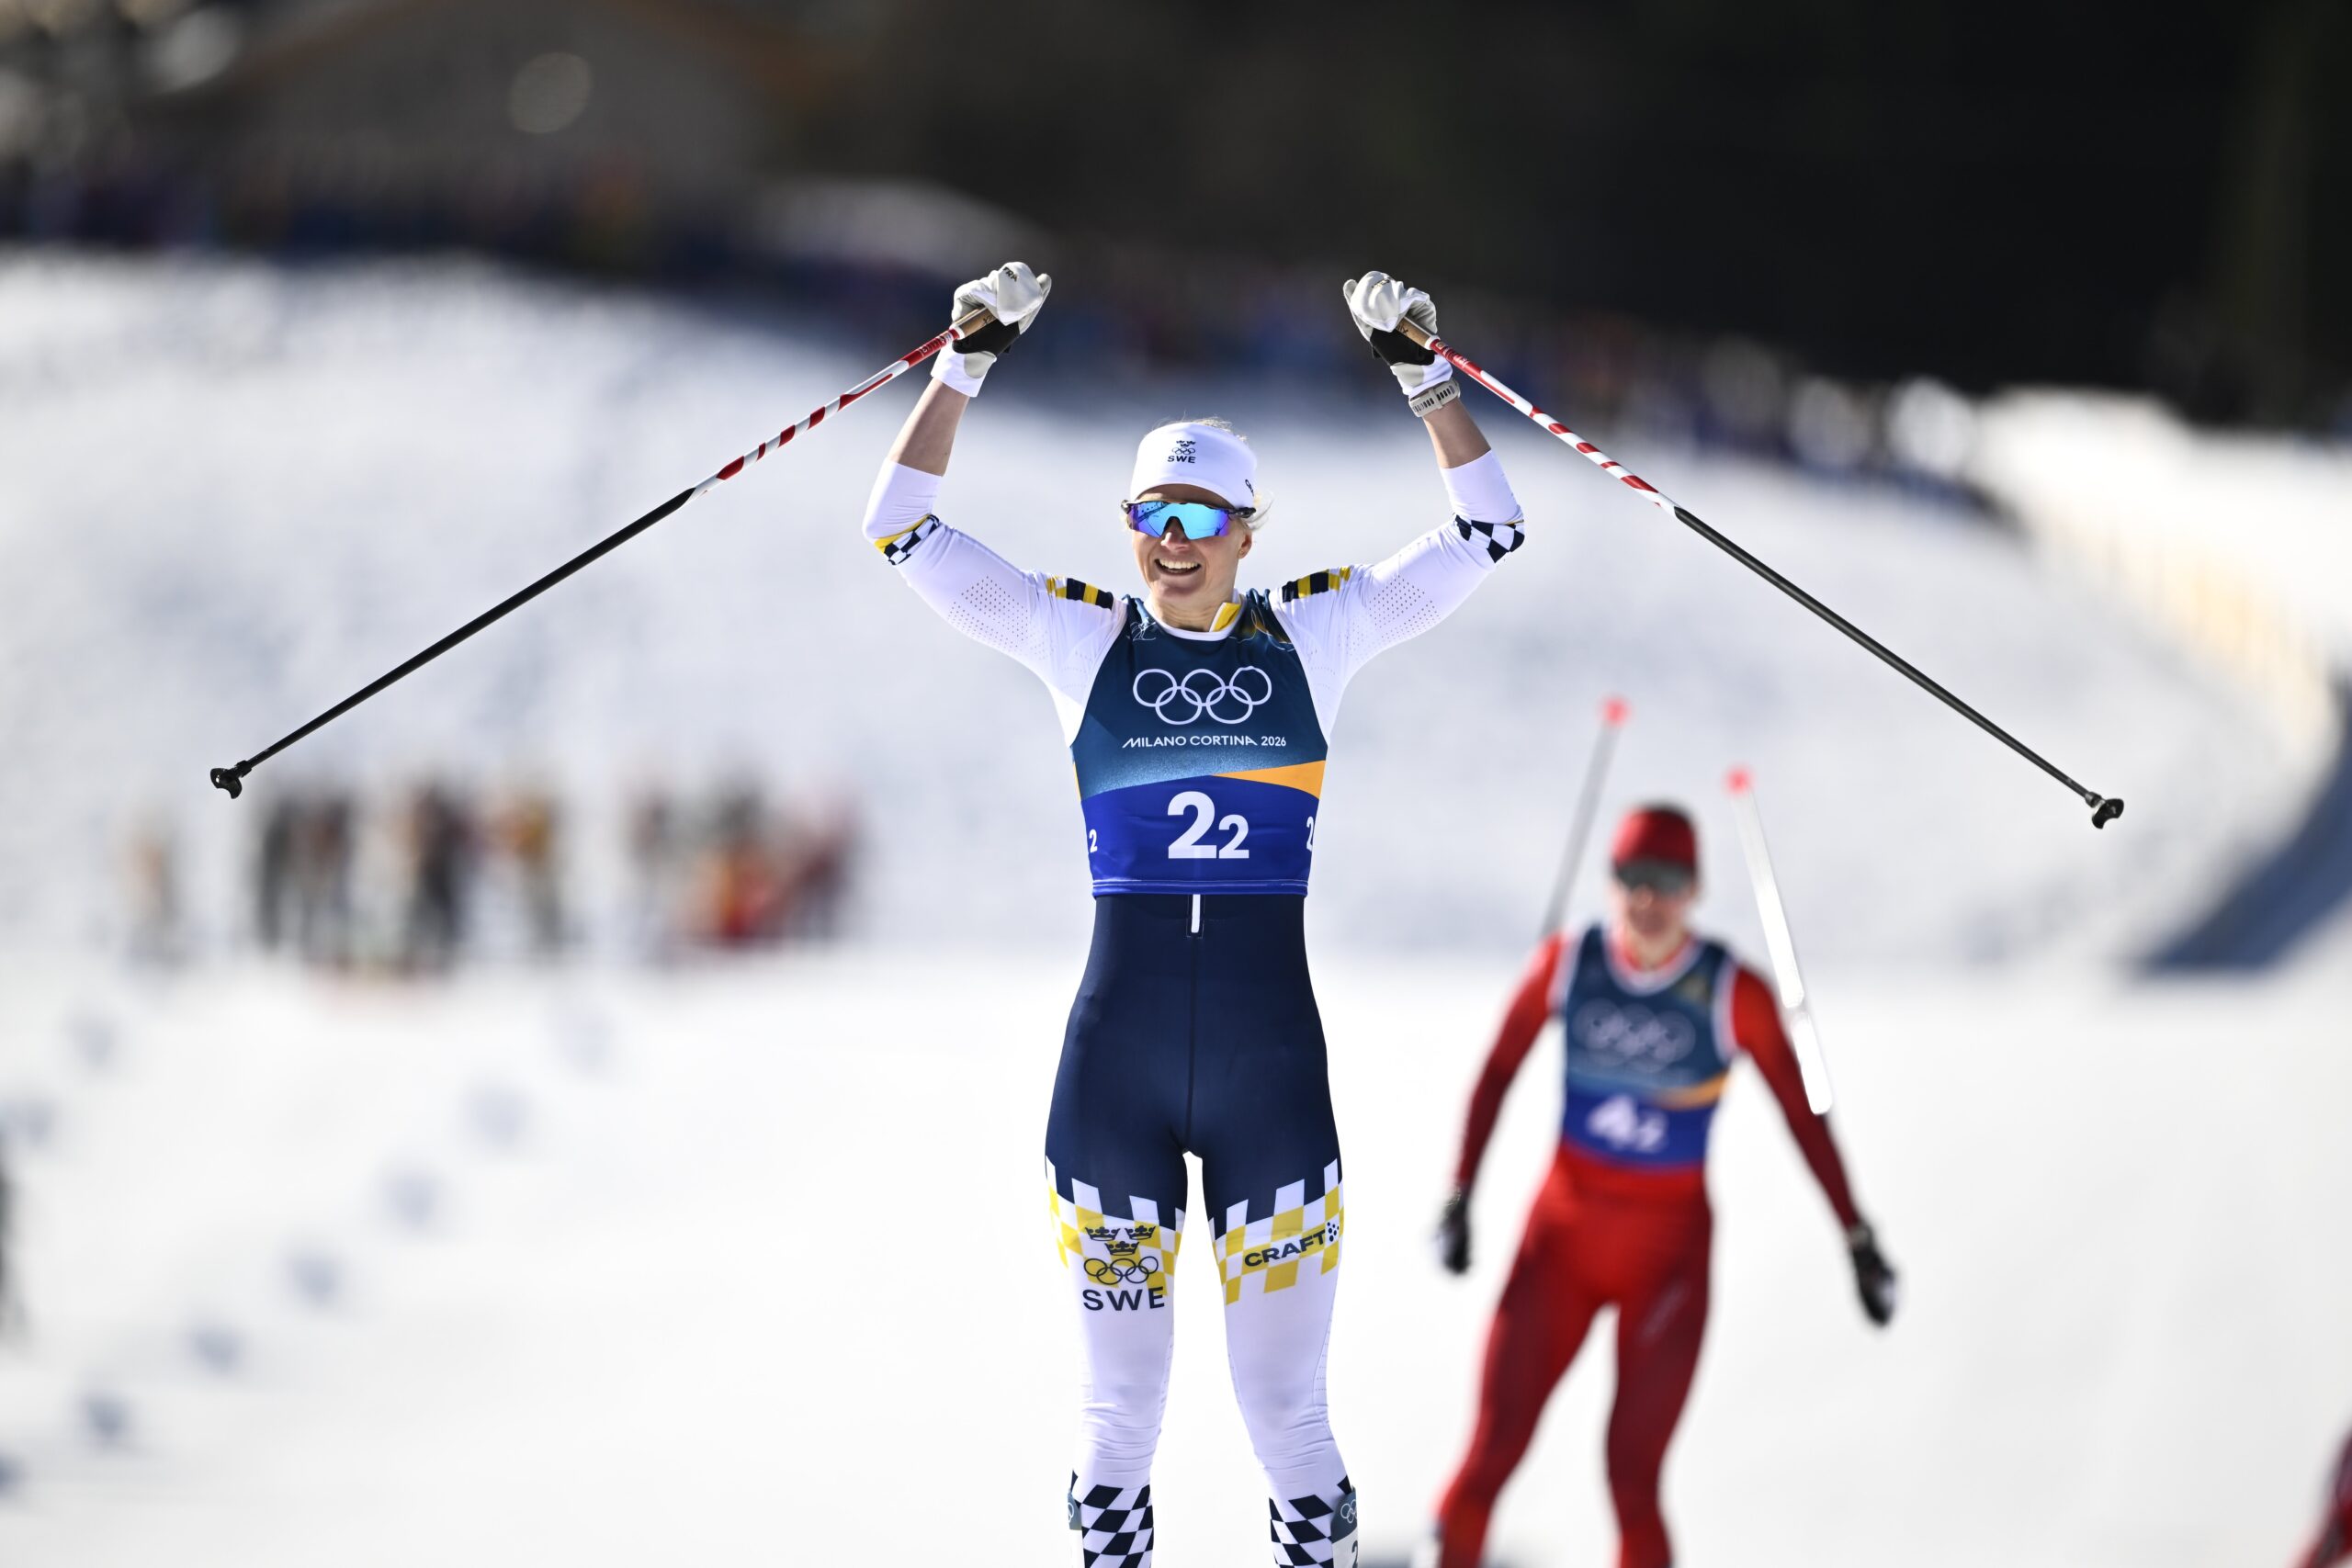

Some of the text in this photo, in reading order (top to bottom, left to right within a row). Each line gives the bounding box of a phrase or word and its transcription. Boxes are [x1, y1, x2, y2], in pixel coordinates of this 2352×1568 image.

[1167, 455, 1196, 463] SWE
[1122, 735, 1286, 749] MILANO CORTINA 2026
[1089, 829, 1098, 853] 2
[1244, 1229, 1327, 1268] CRAFT
[1081, 1286, 1165, 1312] SWE
